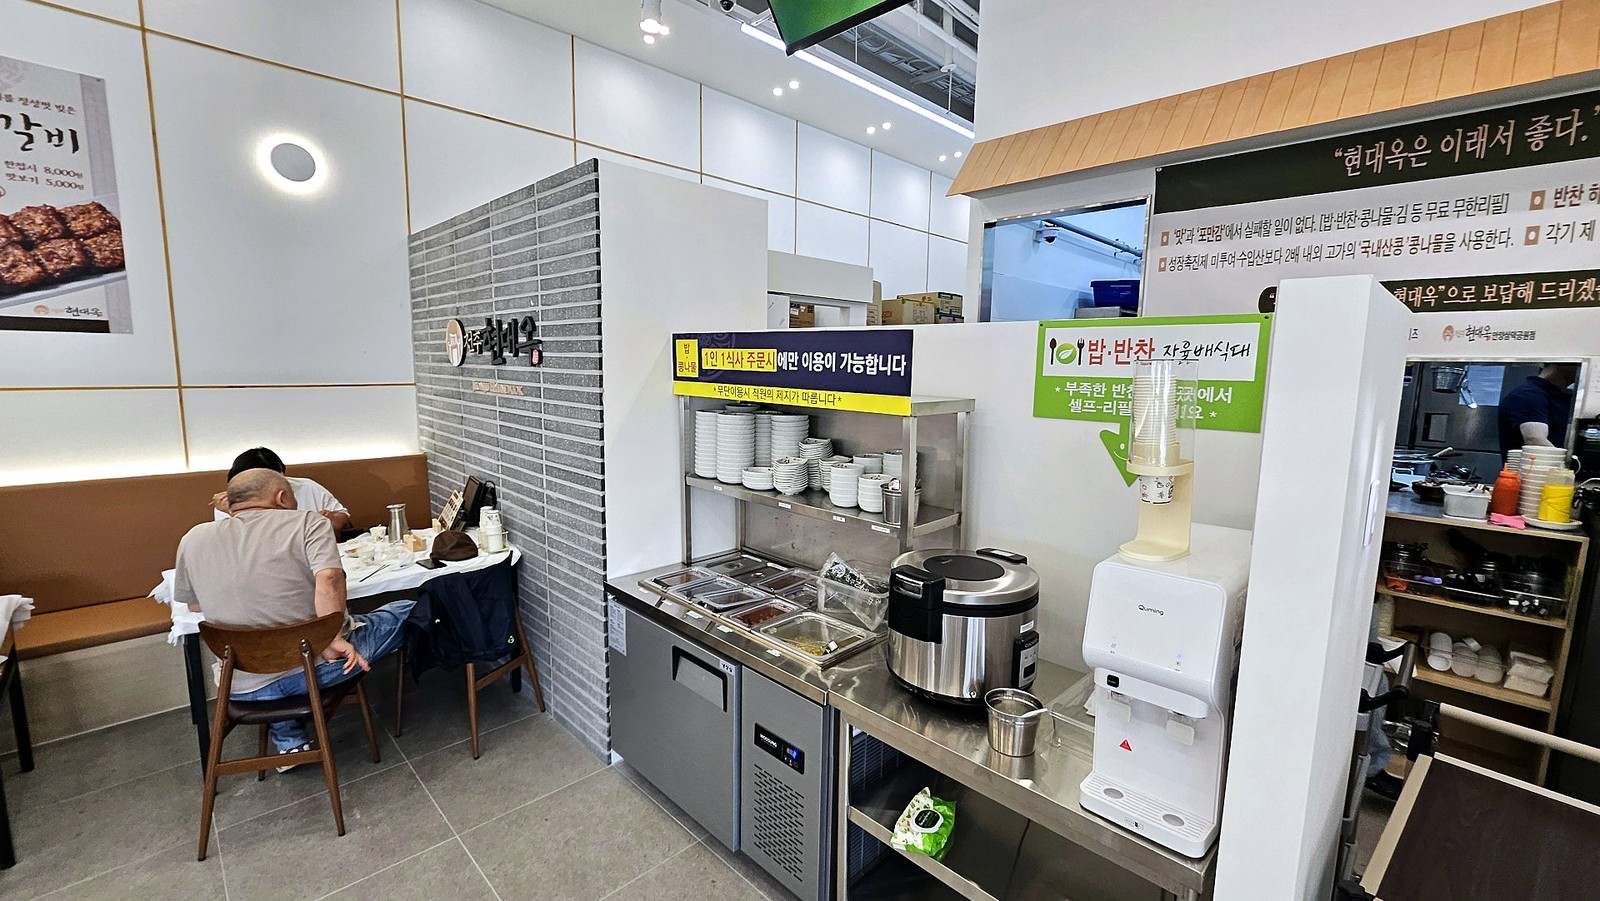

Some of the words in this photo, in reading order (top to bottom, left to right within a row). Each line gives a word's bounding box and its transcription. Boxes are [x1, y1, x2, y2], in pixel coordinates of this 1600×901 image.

[1440, 119, 1515, 164] 이래서
[5, 173, 39, 185] 맛보기
[1553, 183, 1584, 209] 반찬
[1244, 219, 1273, 239] 실패할
[1274, 216, 1293, 236] 일이
[1295, 214, 1317, 235] 없다.
[1410, 206, 1423, 224] 등
[1425, 200, 1450, 220] 무료
[1453, 193, 1509, 219] 무한리필]
[1545, 220, 1576, 245] 각기
[1168, 253, 1208, 273] 성장촉진제
[1285, 247, 1300, 264] 2배
[1302, 243, 1323, 263] 내외
[1325, 240, 1356, 260] 고가의
[1458, 227, 1514, 253] 사용한다.
[1480, 281, 1535, 305] 보답해
[463, 329, 483, 356] 전주
[481, 316, 544, 366] 현대옥
[683, 342, 691, 356] 밥
[677, 361, 698, 374] 콩나물
[704, 350, 718, 368] 1인
[720, 351, 744, 369] 1식사
[802, 351, 838, 374] 이용이
[839, 352, 907, 377] 가능합니다
[752, 388, 775, 402] 직원의
[776, 390, 800, 404] 제지가
[1064, 382, 1107, 398] 부족한
